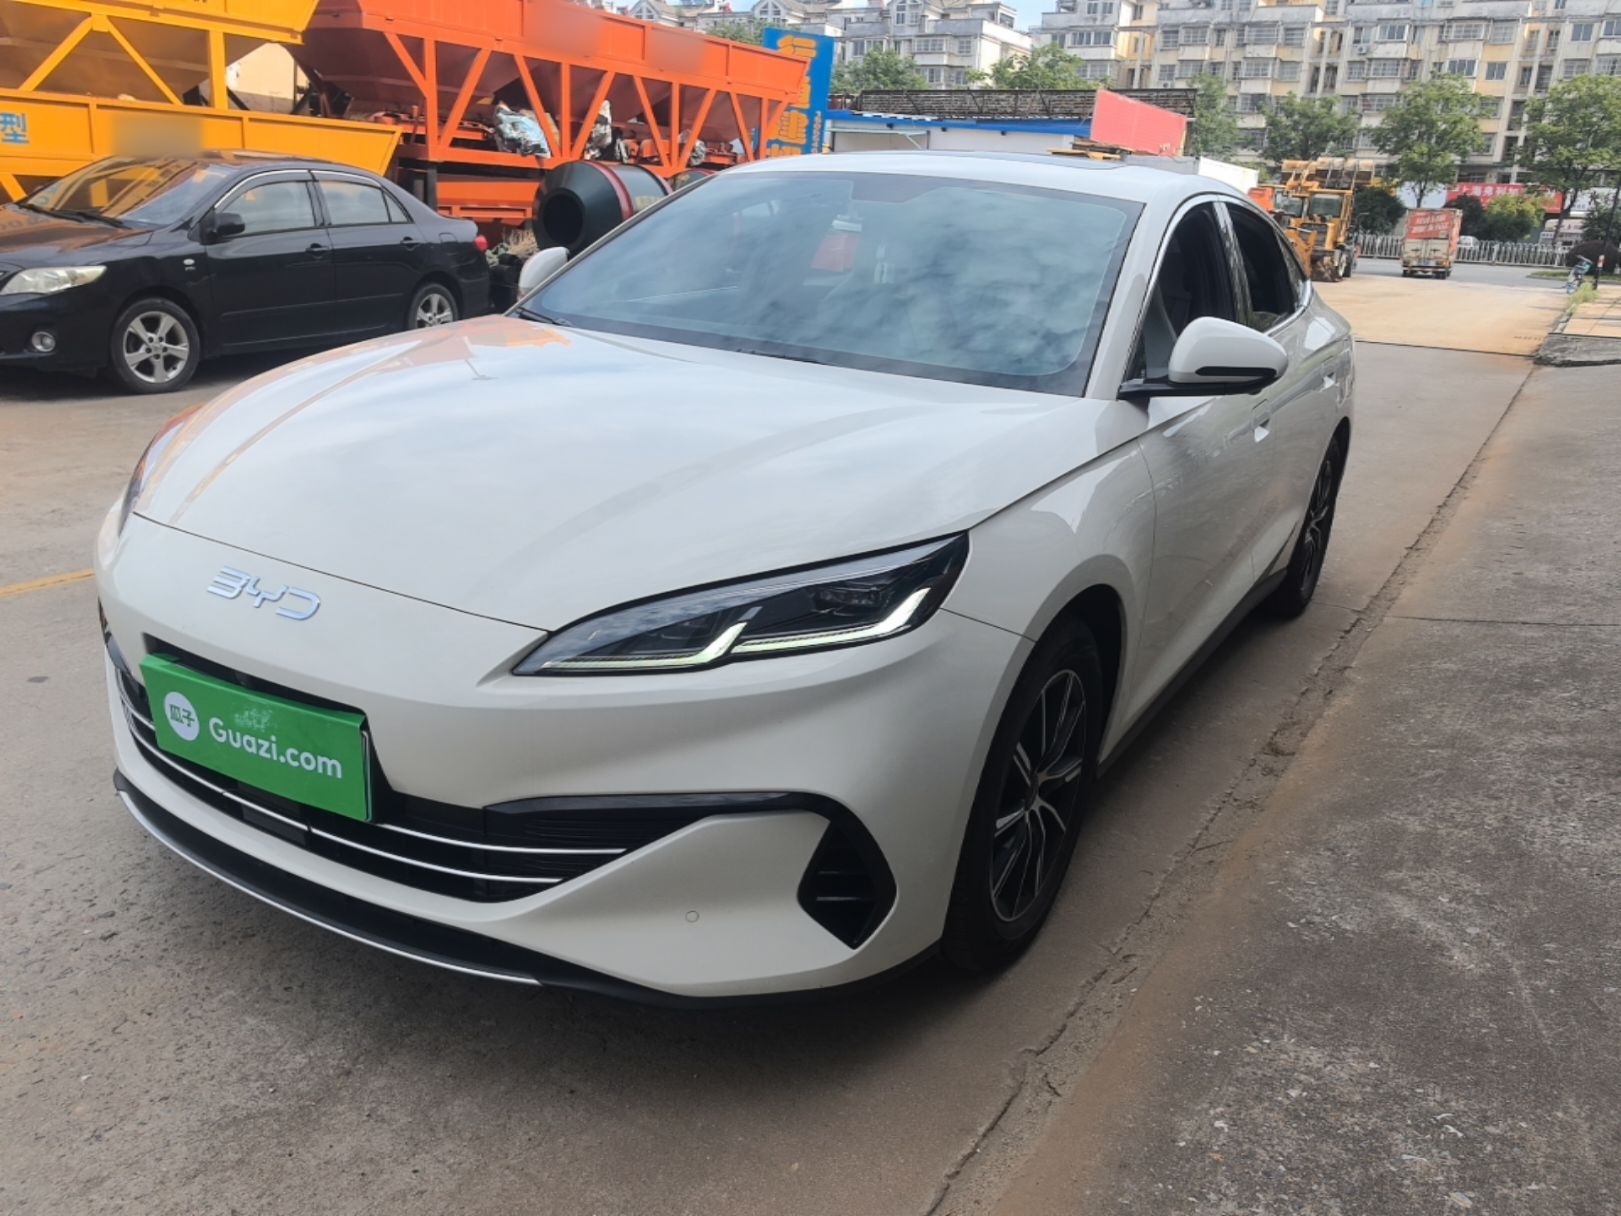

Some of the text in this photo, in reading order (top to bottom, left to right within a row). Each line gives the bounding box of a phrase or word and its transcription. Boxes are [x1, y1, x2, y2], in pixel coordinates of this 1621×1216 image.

[206, 565, 321, 621] BYD
[169, 703, 195, 728] 瓜子
[208, 717, 342, 779] Guazi.com
